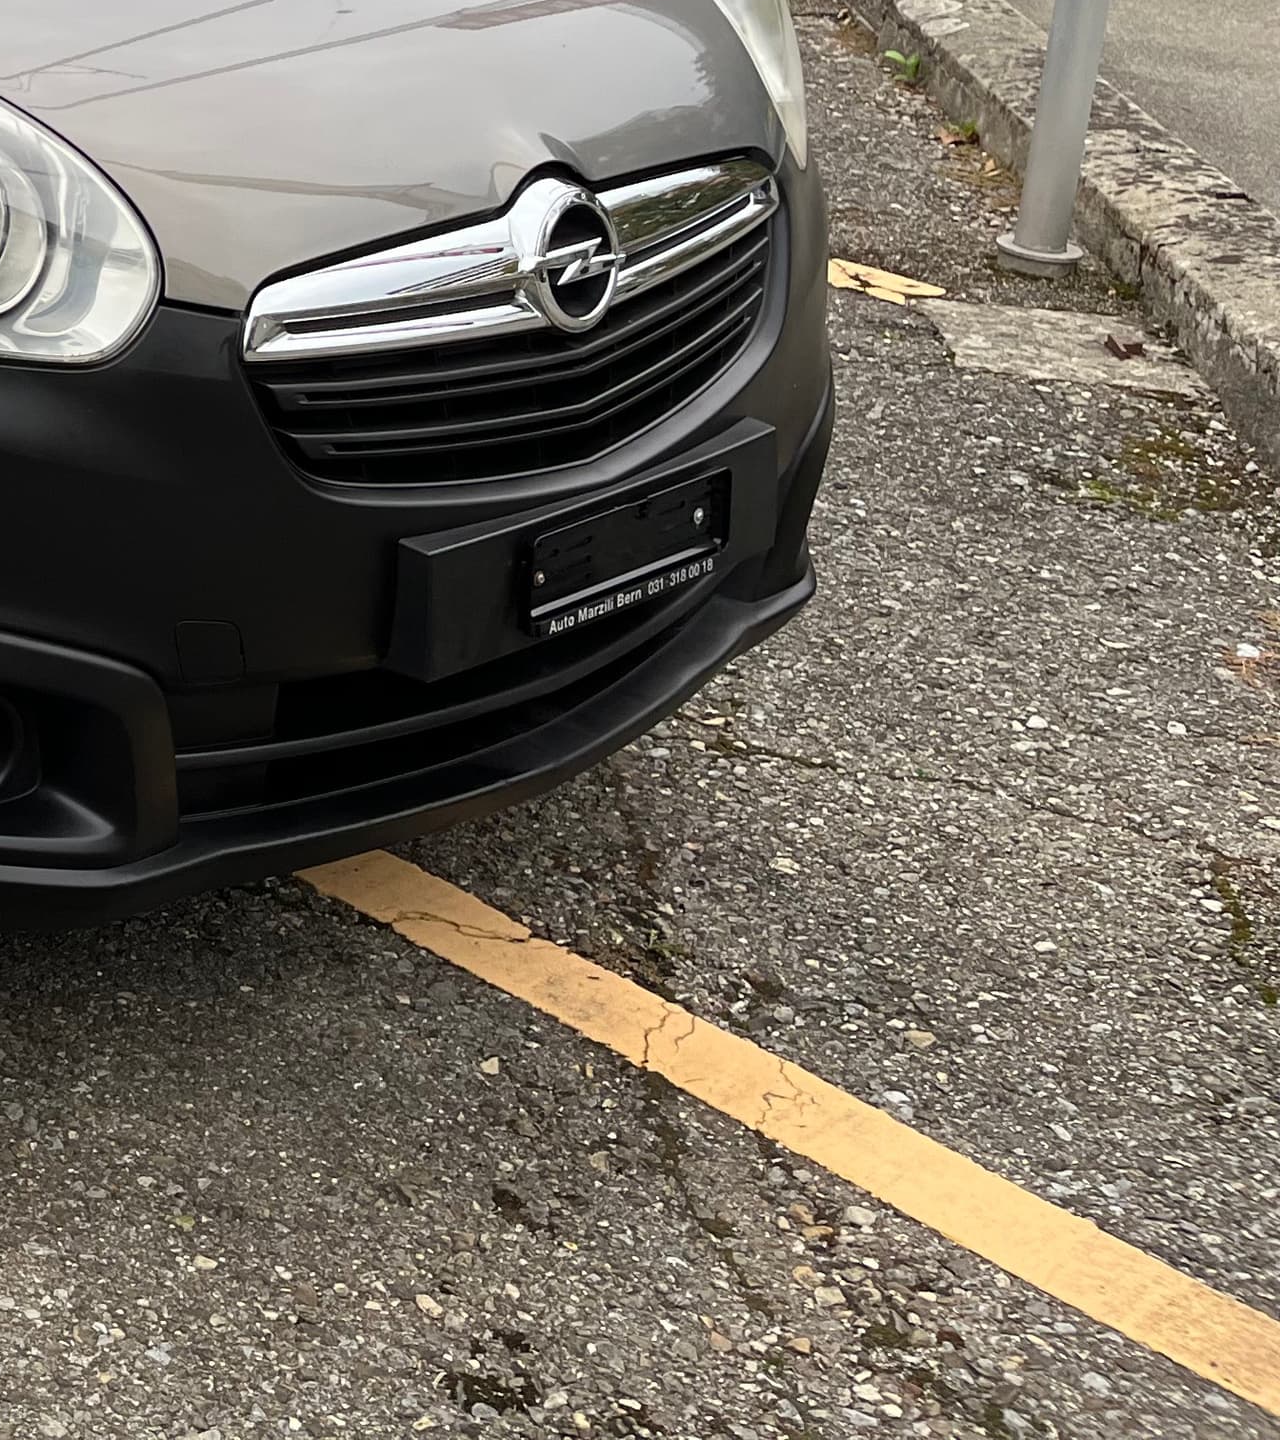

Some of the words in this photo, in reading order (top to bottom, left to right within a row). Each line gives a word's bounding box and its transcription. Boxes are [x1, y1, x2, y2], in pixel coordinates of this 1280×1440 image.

[548, 615, 575, 635] Auto
[578, 596, 614, 623] Marzili
[617, 588, 642, 608] Bern
[647, 578, 665, 596] 031
[670, 568, 687, 587] 318
[688, 563, 700, 579] 00
[702, 558, 714, 572] 18
